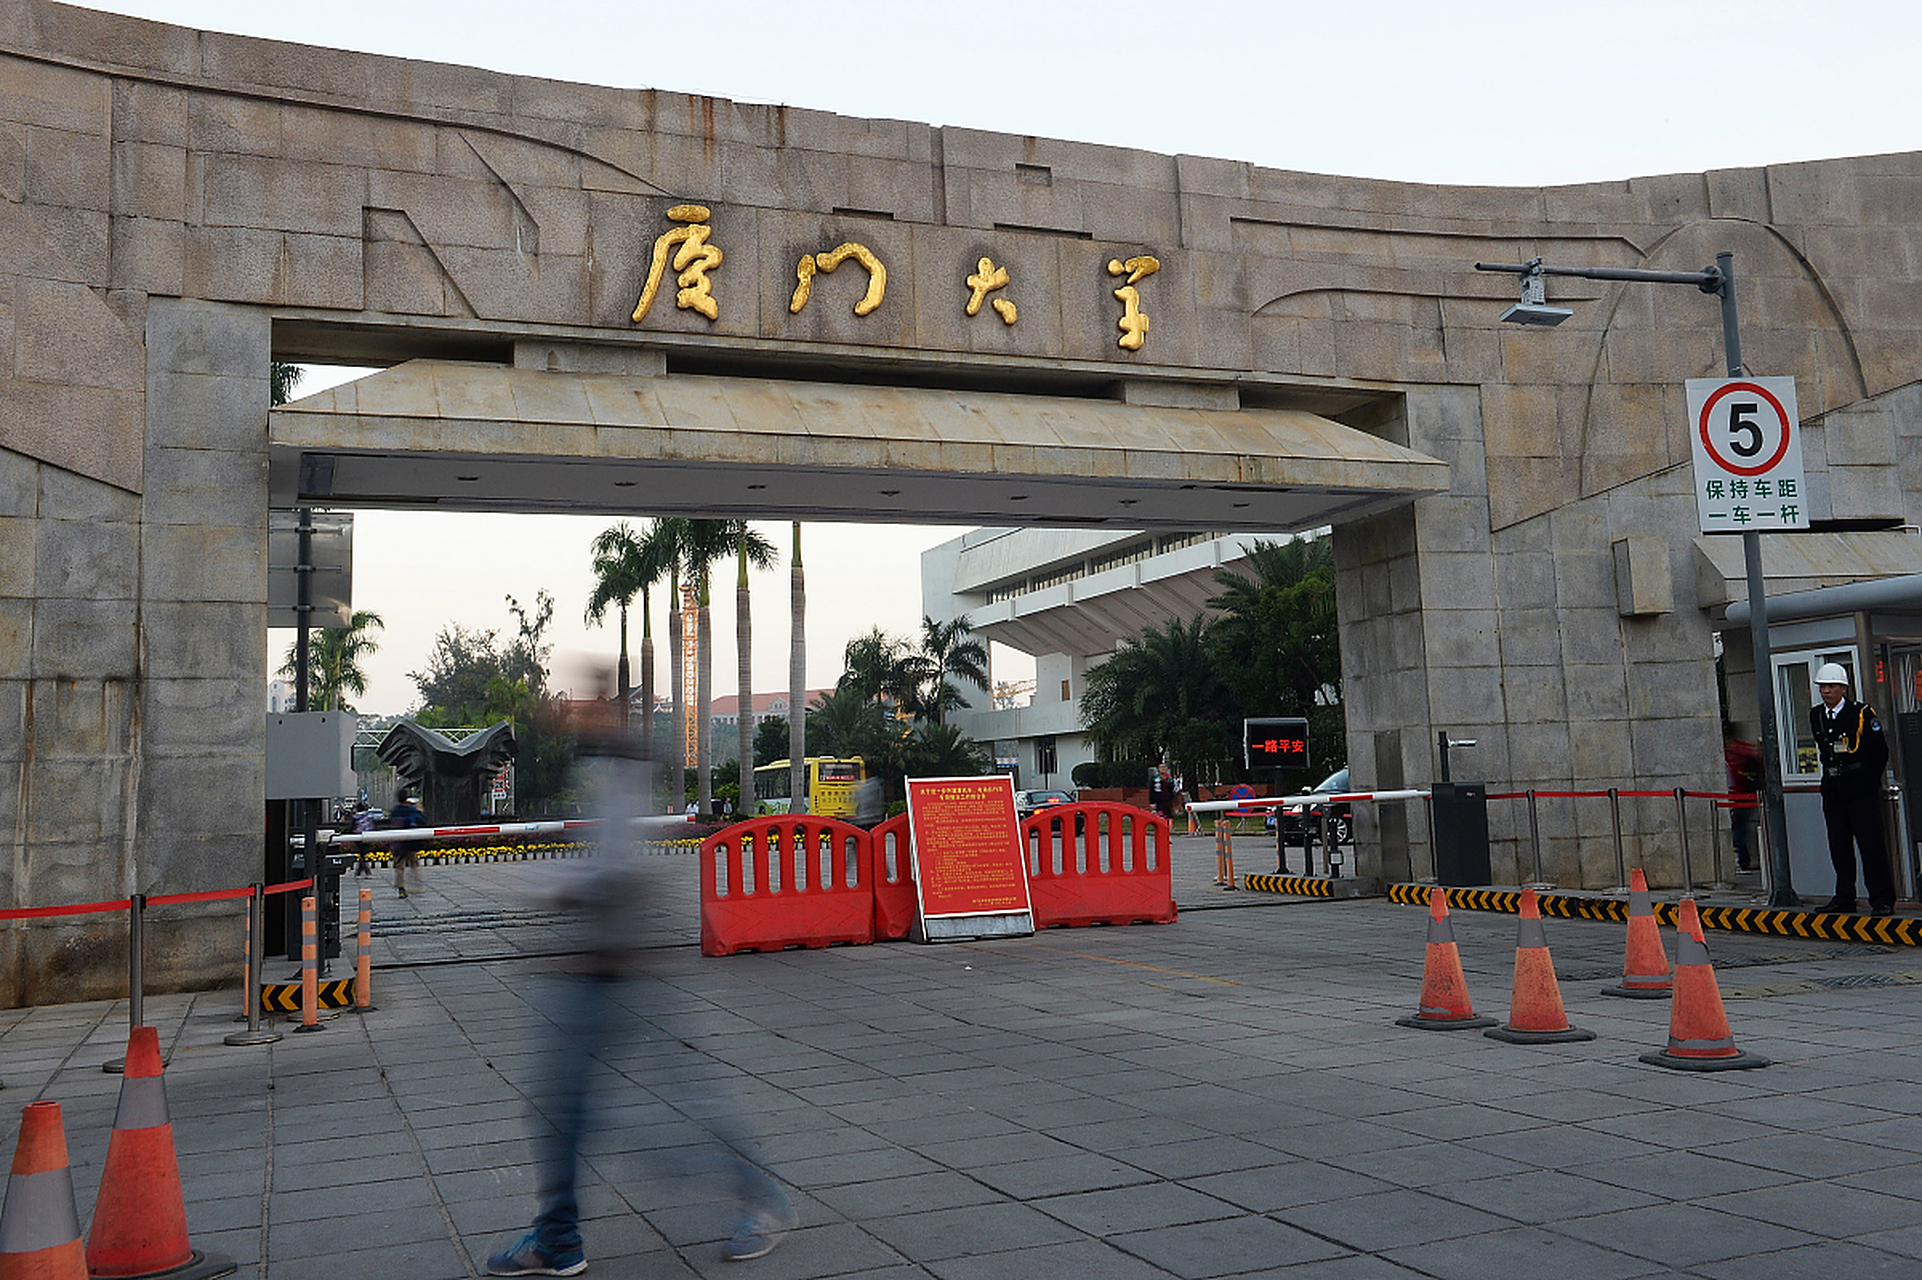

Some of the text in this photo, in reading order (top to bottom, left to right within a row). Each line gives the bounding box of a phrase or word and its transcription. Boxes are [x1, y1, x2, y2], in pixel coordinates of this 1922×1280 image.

[633, 205, 1160, 350] 厦门大学
[1729, 403, 1763, 457] 5
[1706, 478, 1798, 500] 保持车距
[1708, 504, 1799, 525] 一车一杆
[1251, 739, 1304, 753] 一路平安
